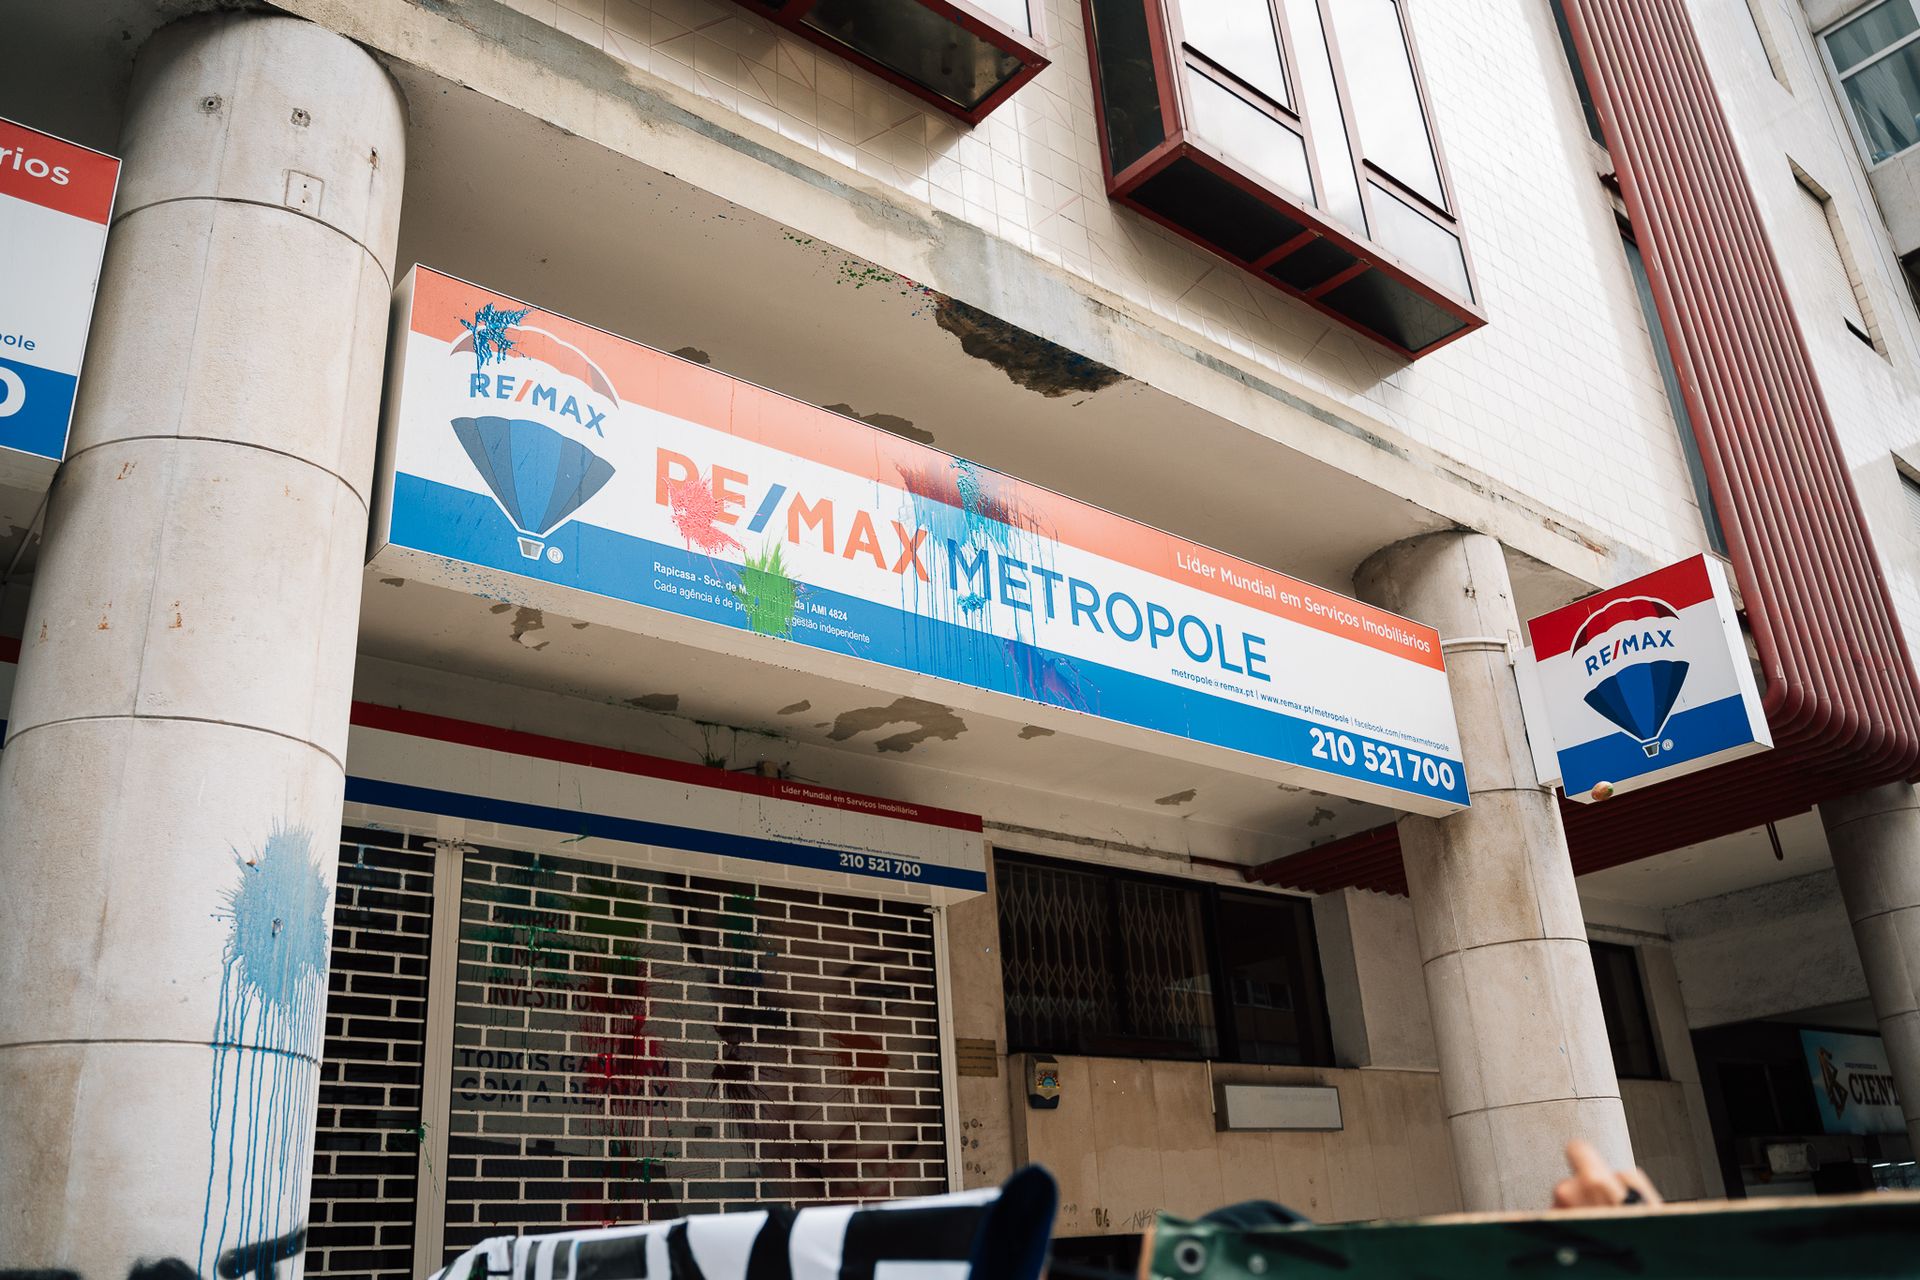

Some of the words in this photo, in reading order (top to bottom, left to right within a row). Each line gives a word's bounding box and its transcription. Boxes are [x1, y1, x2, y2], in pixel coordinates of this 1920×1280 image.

[0, 333, 36, 351] ole
[470, 373, 606, 438] RE/MAX
[656, 447, 930, 583] RE/MAX
[947, 538, 1271, 682] METROPOLE
[653, 561, 696, 582] Rapicasa
[704, 575, 724, 589] Soc.
[726, 581, 738, 592] de
[811, 603, 827, 616] AMI
[828, 608, 848, 621] 4824
[653, 579, 677, 594] Cada
[679, 588, 713, 603] agência
[714, 595, 720, 605] é
[722, 597, 733, 608] de
[791, 617, 818, 630] gestão
[819, 622, 871, 643] independente
[1177, 551, 1216, 578] Líder
[1220, 569, 1277, 600] Mundial
[1280, 590, 1302, 609] em
[1304, 597, 1360, 628] Serviços
[1362, 616, 1431, 653] Imobiliários
[1584, 629, 1675, 676] RE/MAX
[1260, 693, 1349, 724] www.remax.pt/metropole
[1309, 727, 1356, 766] 210
[1362, 741, 1404, 778] 521
[1407, 753, 1456, 791] 700
[781, 786, 801, 795] Líder
[803, 789, 832, 800] Mundial
[846, 797, 877, 809] Serviços
[878, 802, 918, 816] Imobiliários
[840, 853, 864, 868] 210
[868, 857, 890, 873] 521
[894, 861, 921, 877] 700
[460, 1049, 549, 1072] TODOS
[460, 1077, 521, 1102] COM
[533, 1081, 550, 1104] A
